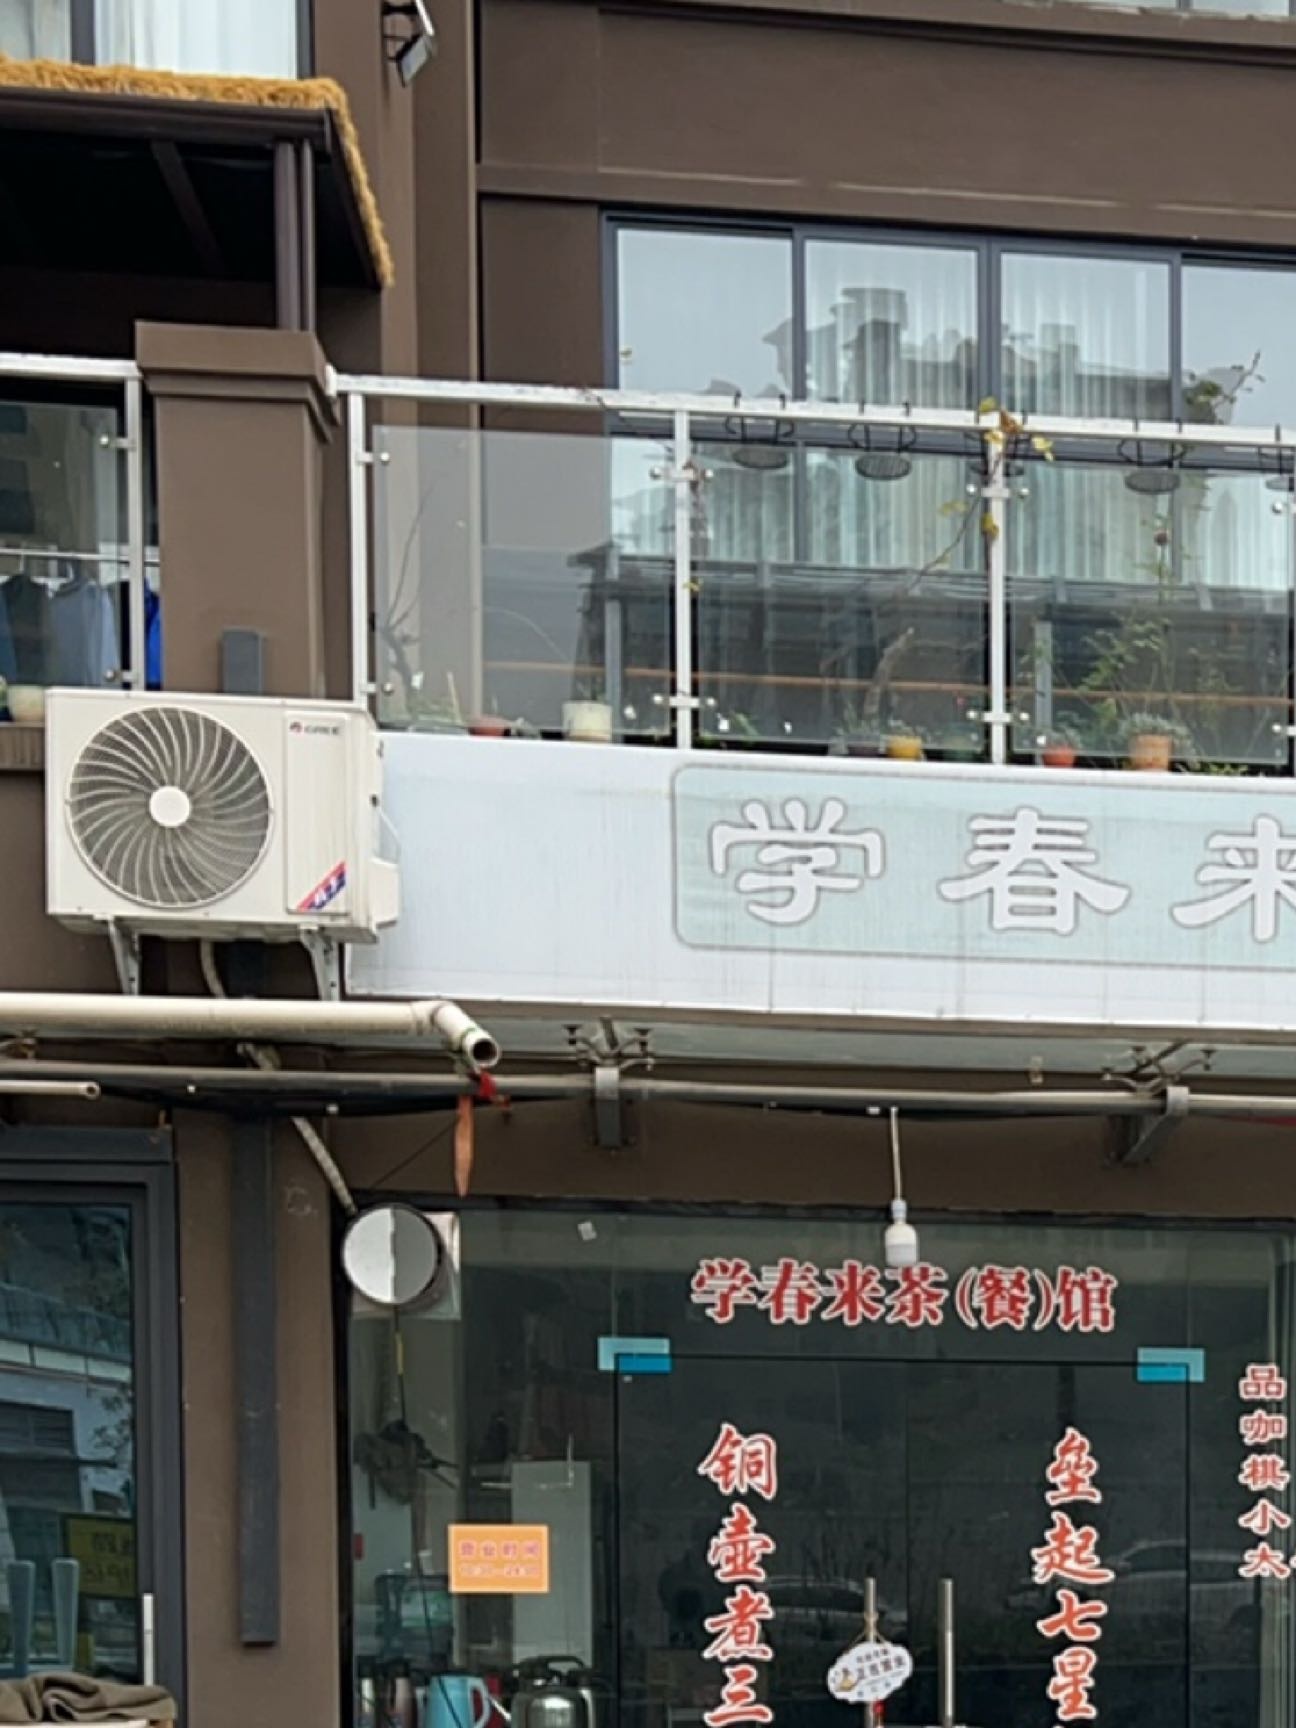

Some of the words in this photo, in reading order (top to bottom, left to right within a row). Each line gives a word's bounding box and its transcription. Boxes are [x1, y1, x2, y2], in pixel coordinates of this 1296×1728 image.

[691, 1258, 1117, 1332] 学春来茶(餐)馆
